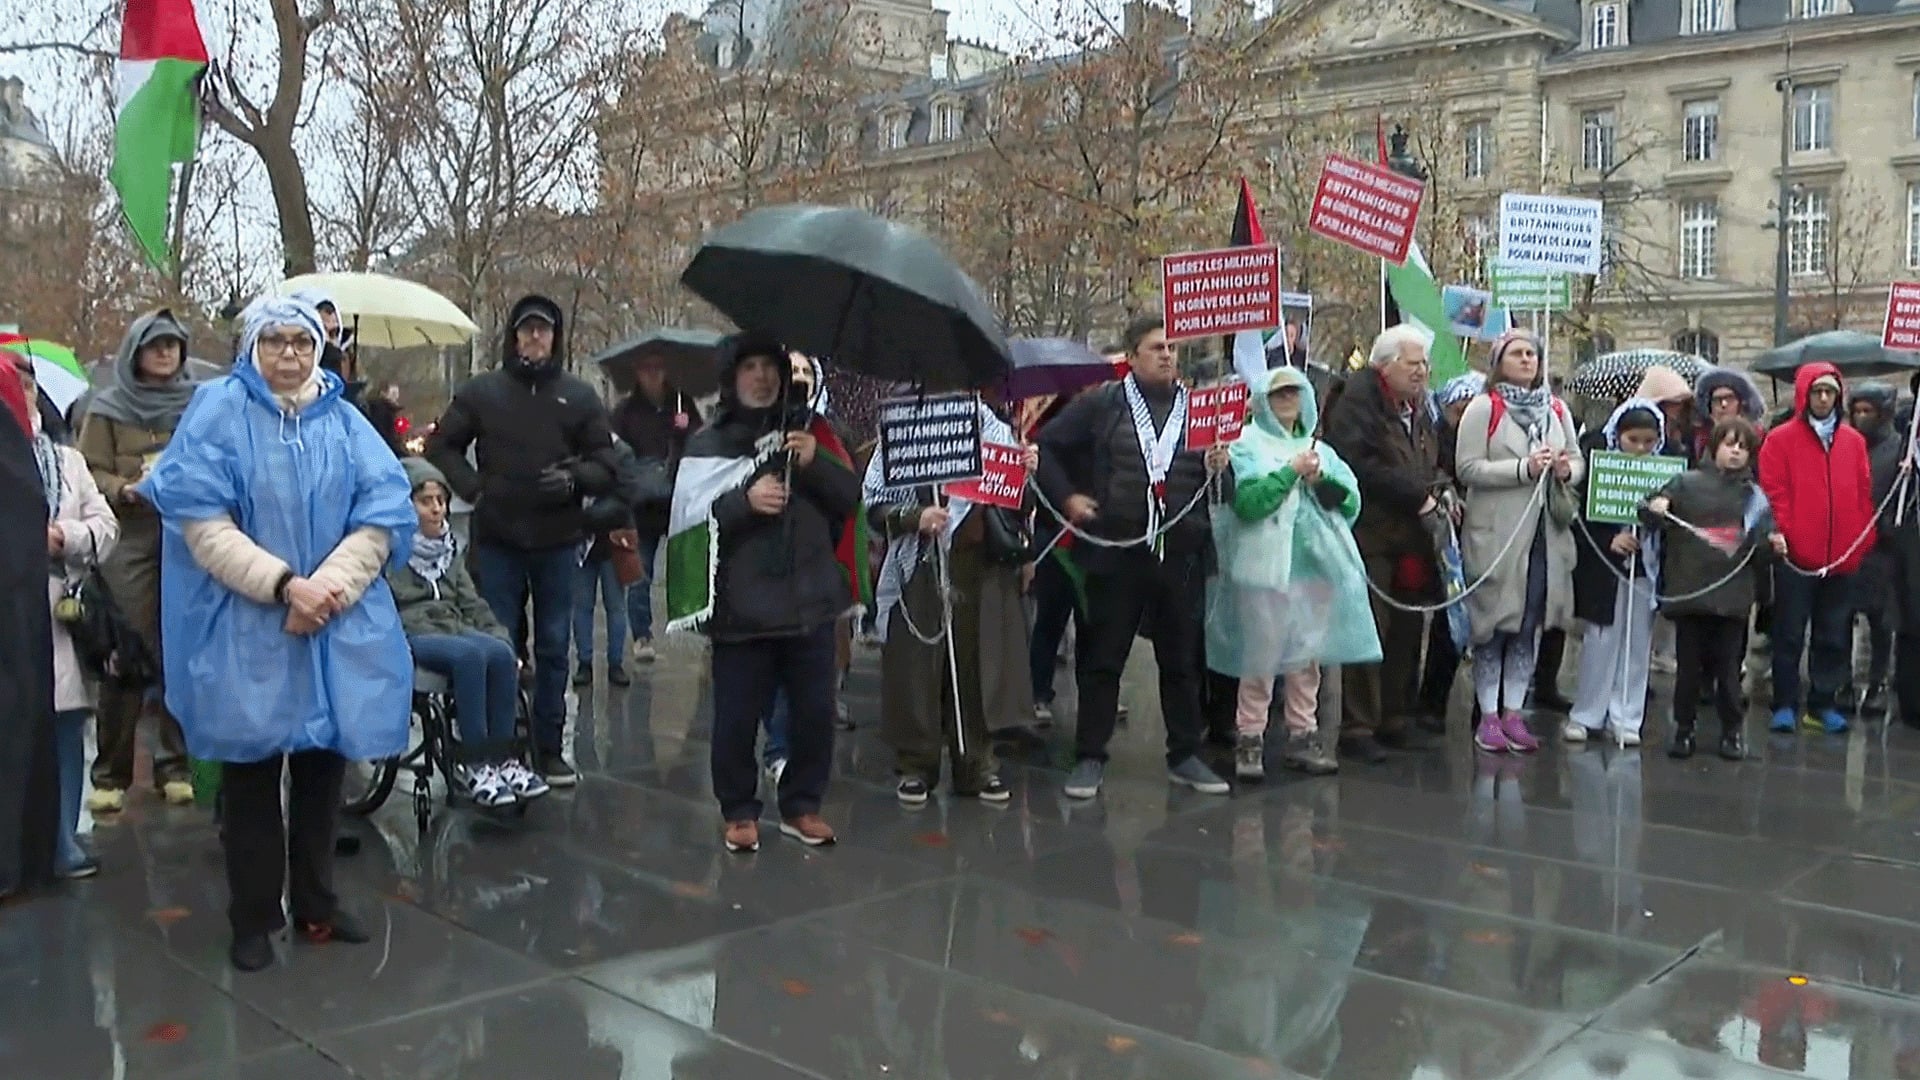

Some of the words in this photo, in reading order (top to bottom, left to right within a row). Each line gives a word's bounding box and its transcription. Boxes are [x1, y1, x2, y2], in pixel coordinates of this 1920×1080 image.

[1510, 217, 1592, 233] BRITANNIQUES
[1205, 258, 1224, 272] LES
[1173, 272, 1270, 294] BRITANNIQUES
[1218, 296, 1232, 308] DE
[1232, 294, 1246, 306] LA
[1246, 290, 1270, 304] FAIM
[1174, 316, 1200, 332] POUR
[1201, 315, 1214, 329] LA
[1214, 310, 1265, 327] PALESTINE
[888, 420, 972, 442] BRITANNIQUES
[1000, 452, 1022, 466] ALL
[978, 482, 1020, 499] ACTION
